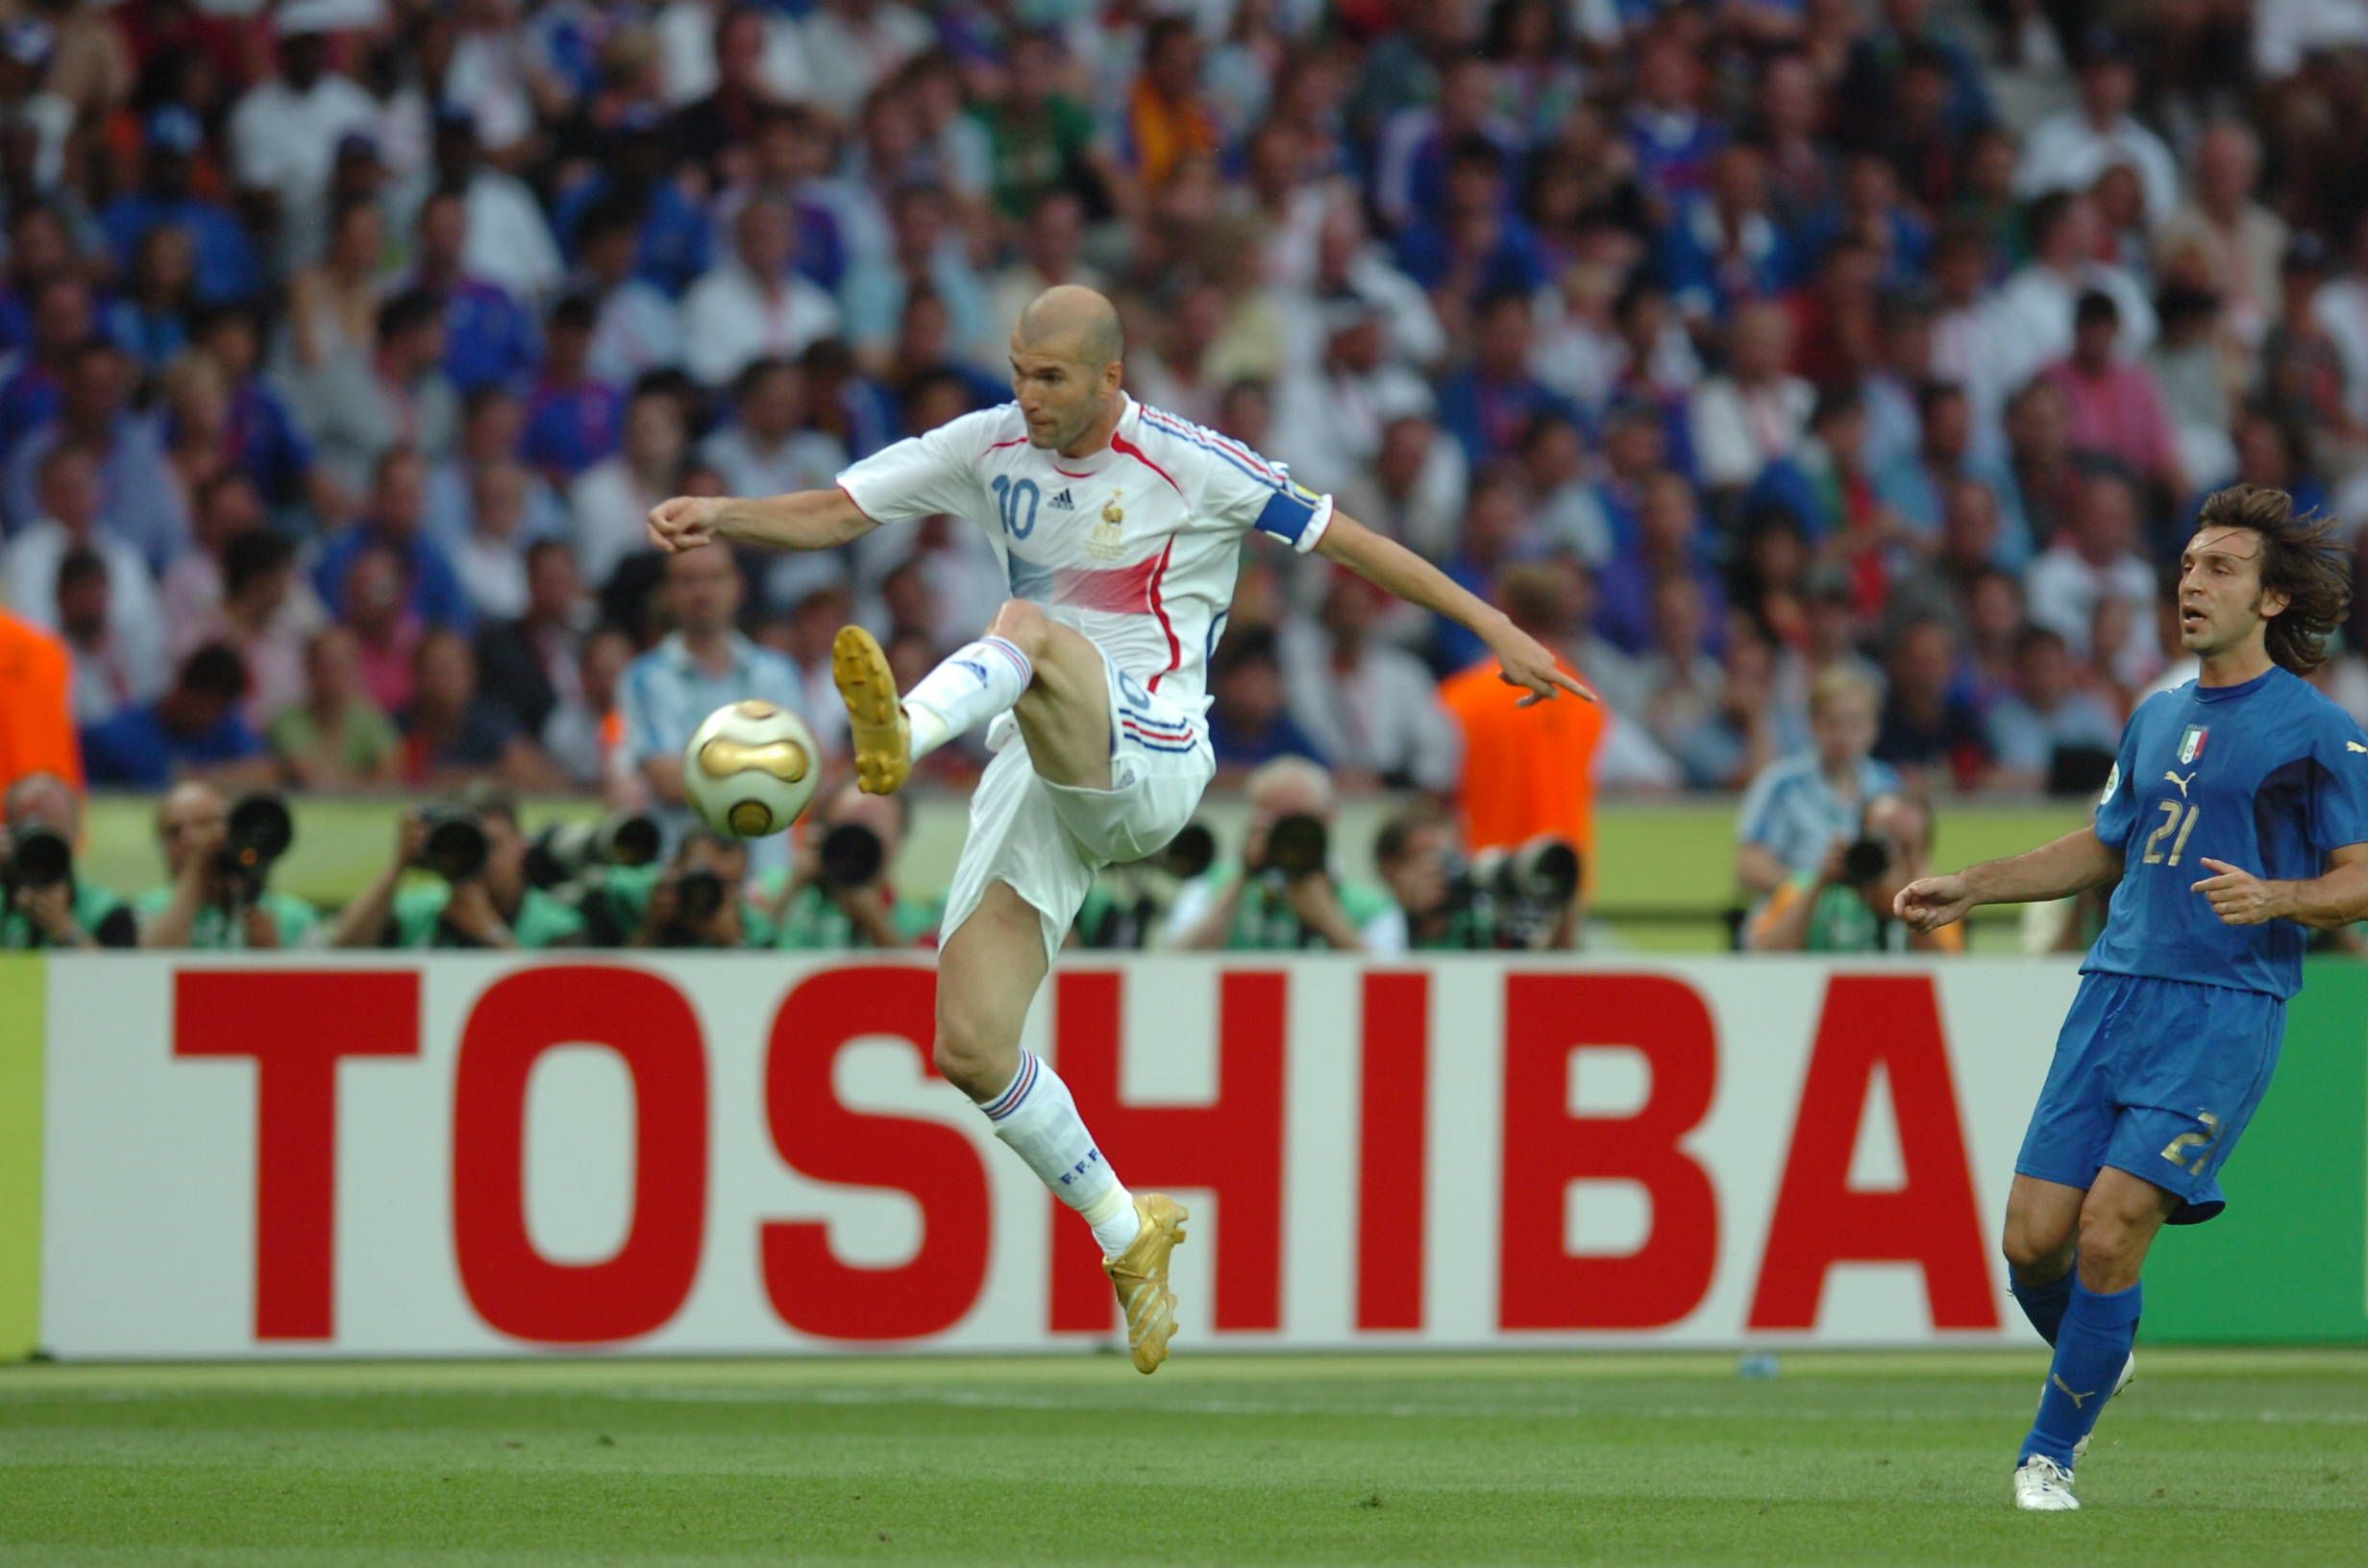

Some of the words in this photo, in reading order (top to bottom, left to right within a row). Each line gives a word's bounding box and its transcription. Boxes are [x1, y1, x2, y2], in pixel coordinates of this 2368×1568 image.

[992, 475, 1040, 540] 10
[2142, 799, 2200, 867] 21
[174, 964, 2002, 1346] TOSHIBA
[2160, 1112, 2228, 1176] 21
